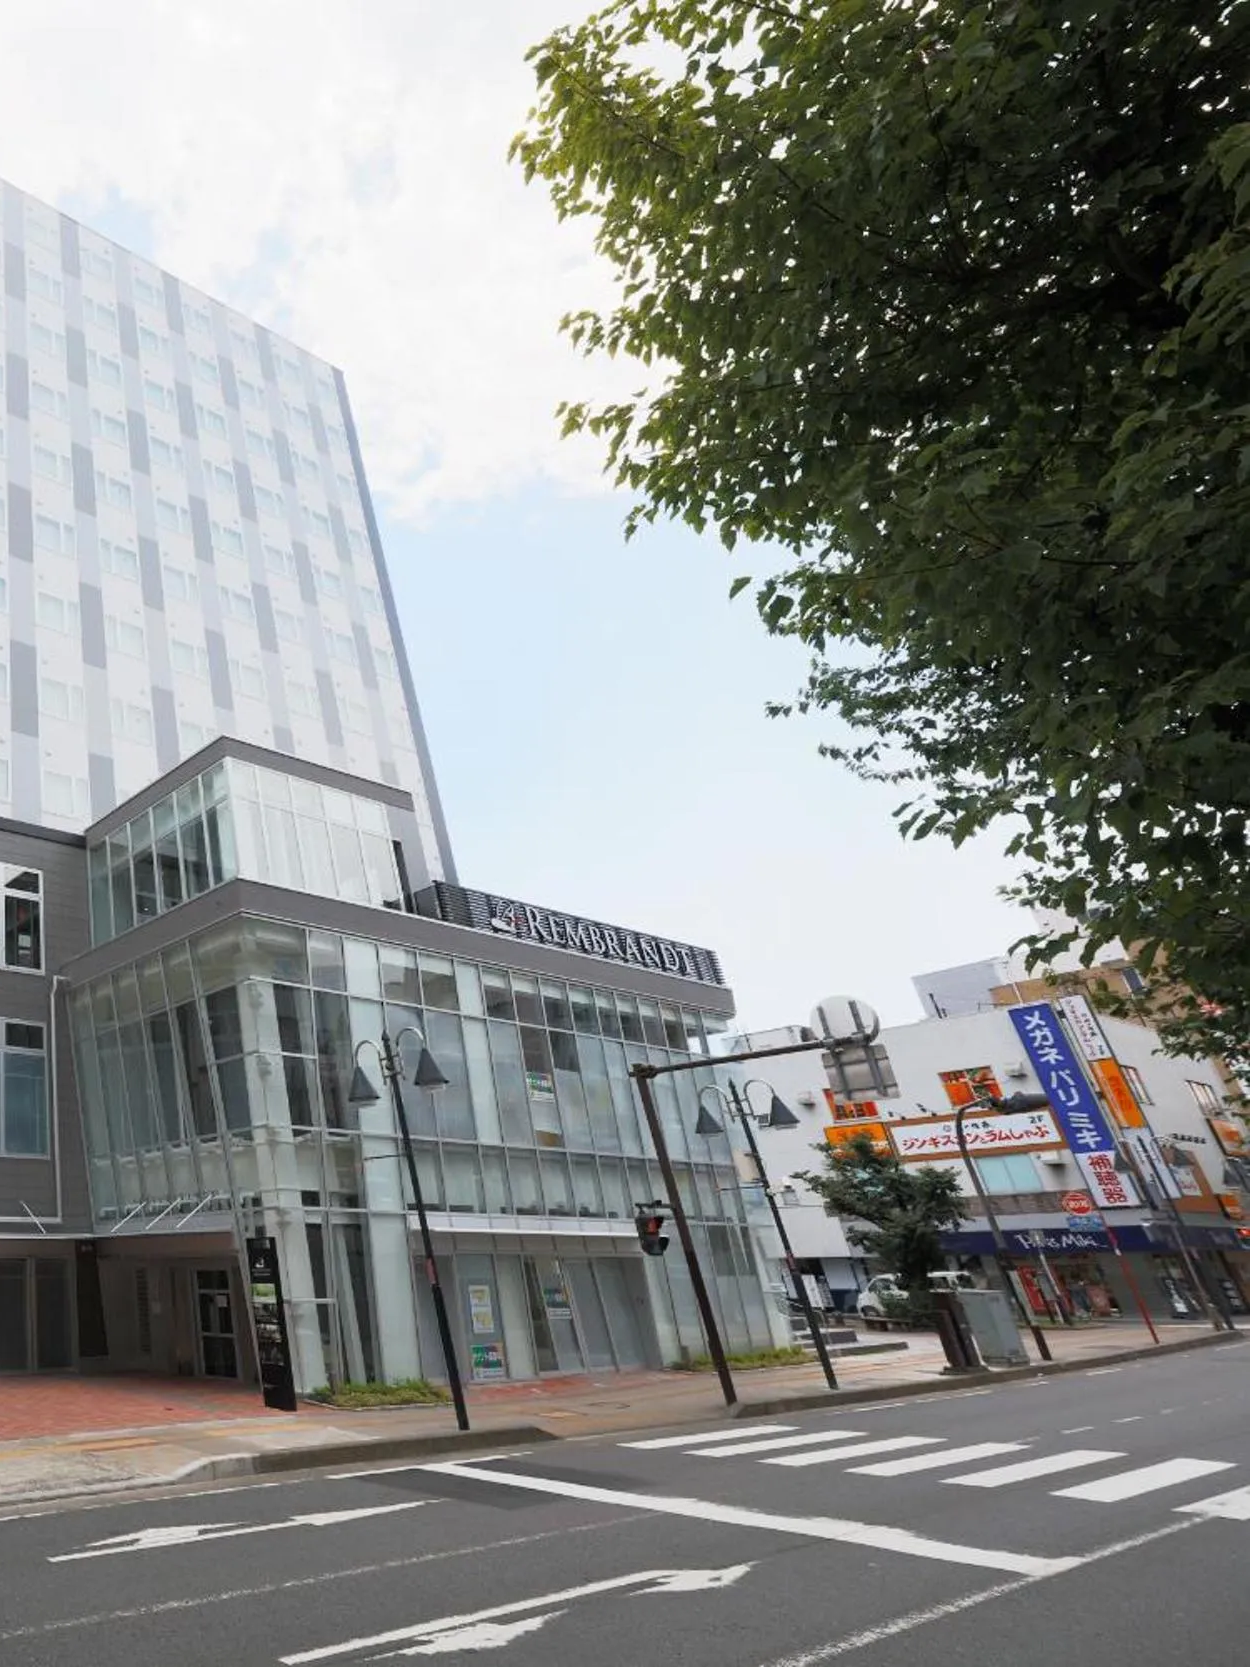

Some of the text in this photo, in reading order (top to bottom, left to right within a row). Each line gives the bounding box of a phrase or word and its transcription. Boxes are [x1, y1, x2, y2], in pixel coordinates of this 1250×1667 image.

[525, 906, 693, 972] REMBRANDT
[1087, 1154, 1128, 1204] 補聴器
